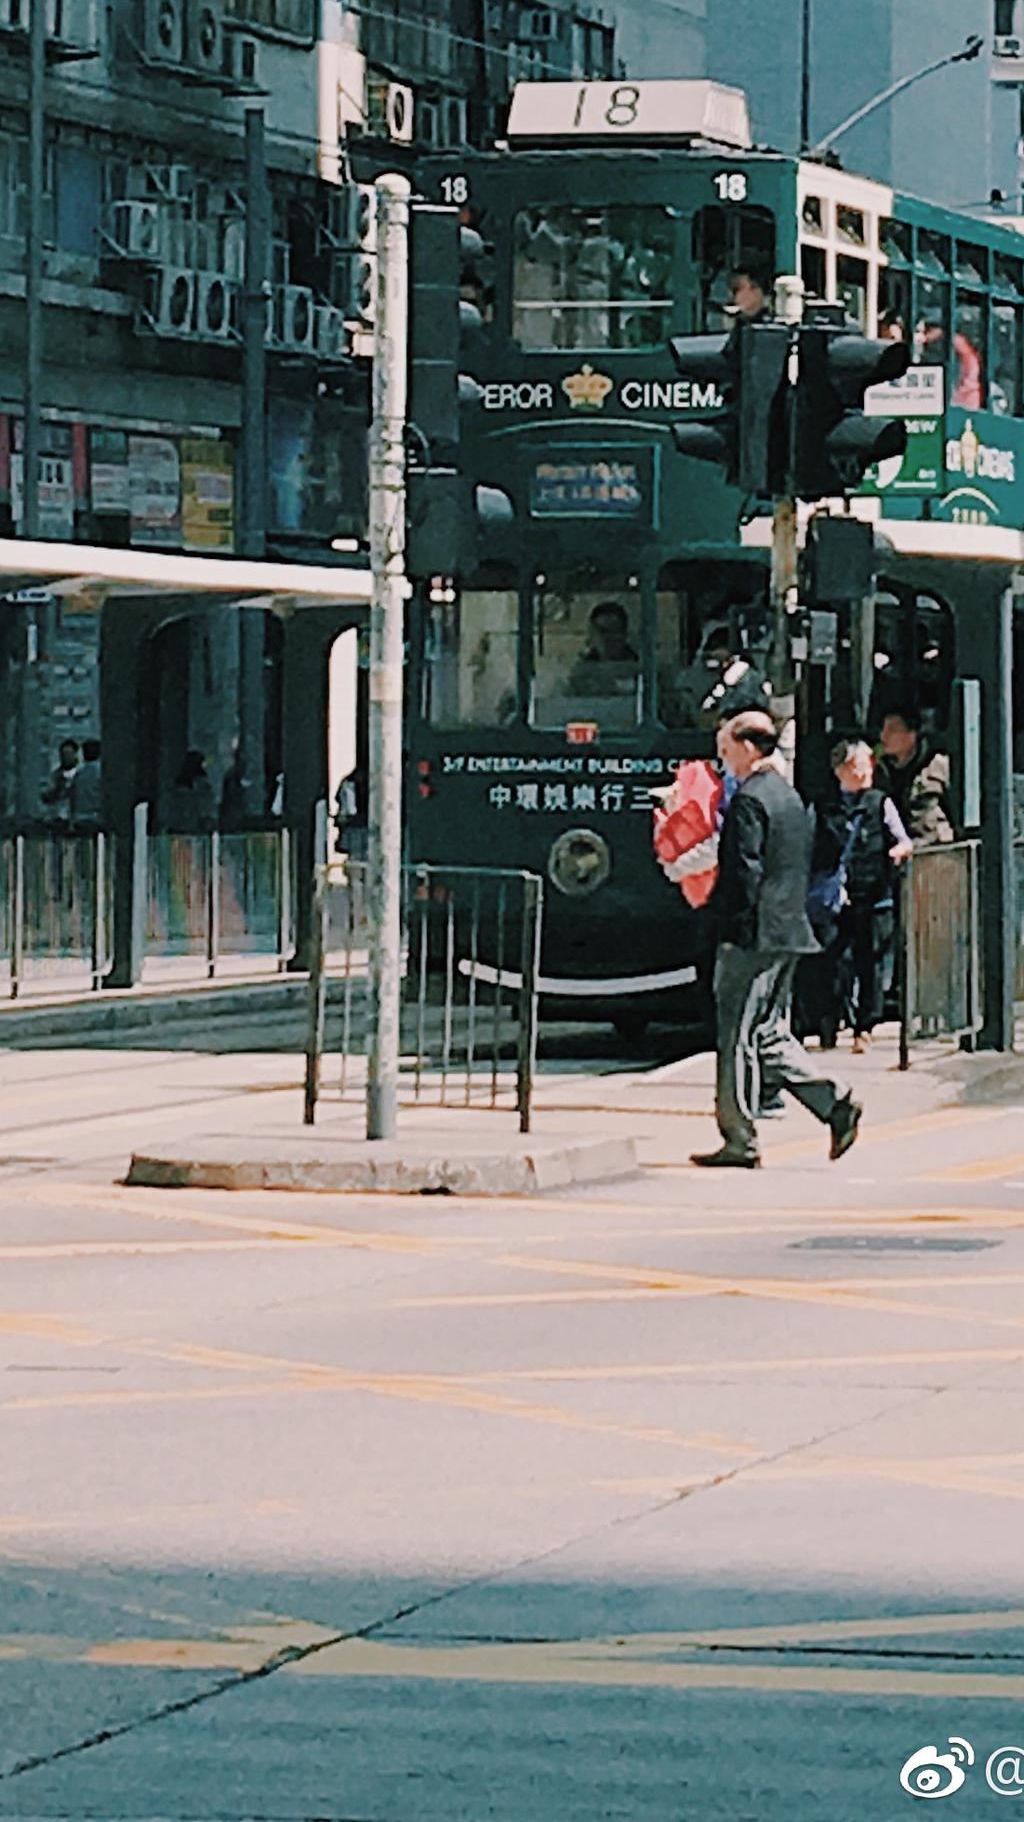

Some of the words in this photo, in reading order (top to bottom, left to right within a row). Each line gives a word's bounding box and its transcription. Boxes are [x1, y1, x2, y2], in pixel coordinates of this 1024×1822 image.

[574, 86, 641, 128] 18
[441, 177, 469, 204] 18
[713, 173, 747, 201] 18
[620, 382, 724, 409] CINEM
[467, 756, 584, 773] ENTERTAINMENT
[588, 757, 662, 774] BUILDING
